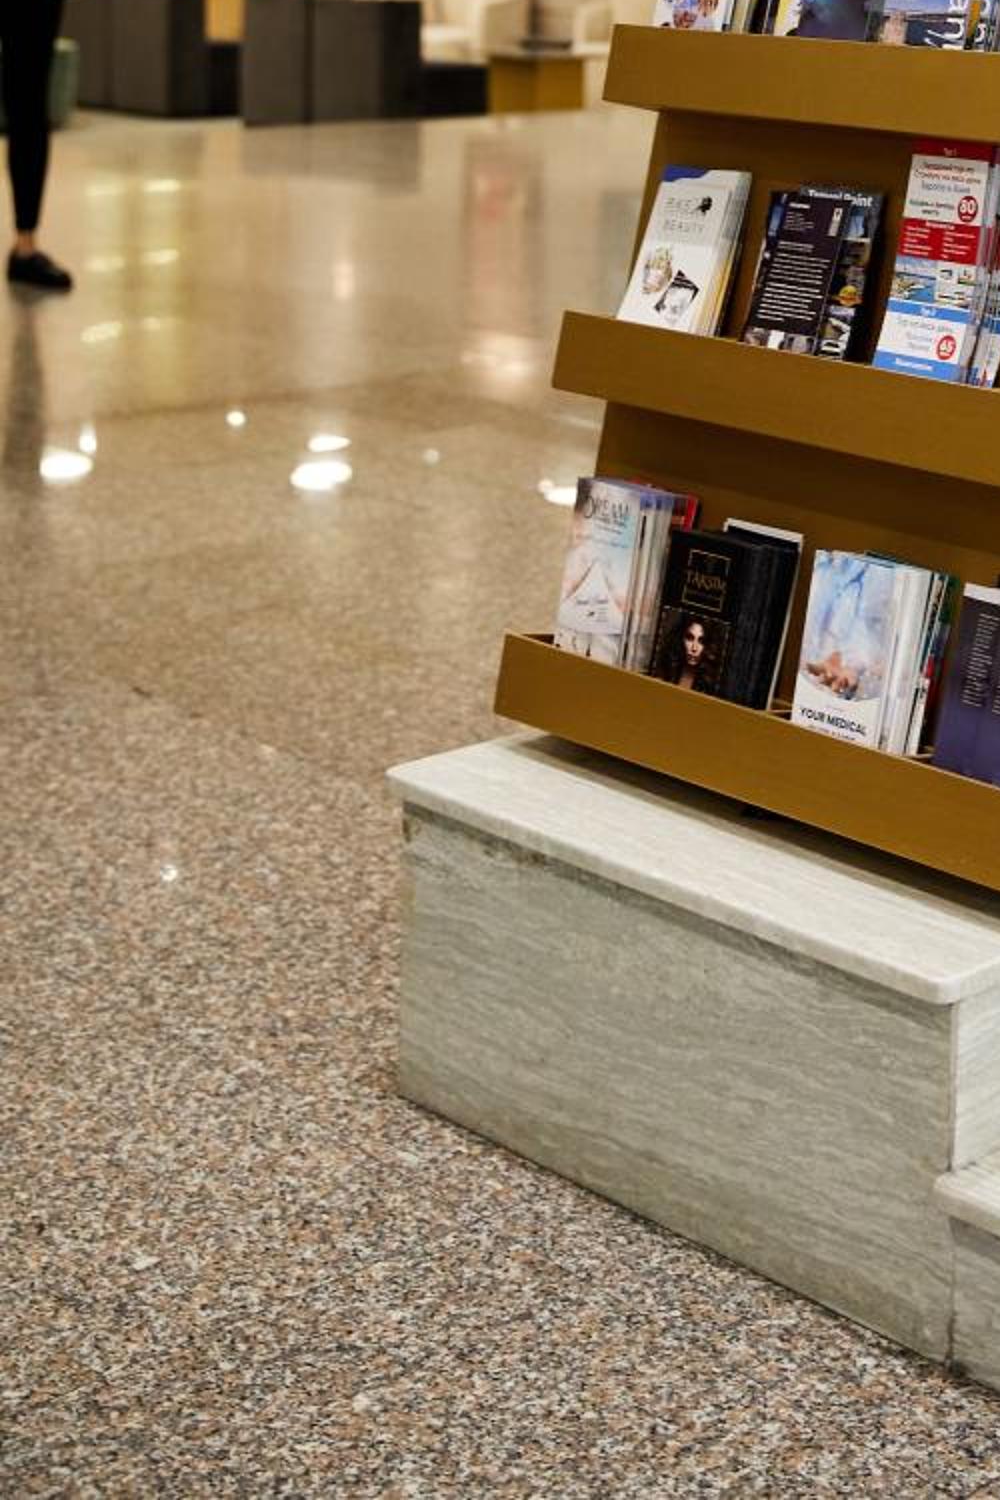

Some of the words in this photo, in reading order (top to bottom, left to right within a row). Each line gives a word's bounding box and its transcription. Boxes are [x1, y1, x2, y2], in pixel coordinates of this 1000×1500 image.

[959, 199, 976, 215] 80
[801, 707, 825, 722] YOUR
[826, 714, 867, 737] MEDICAL
